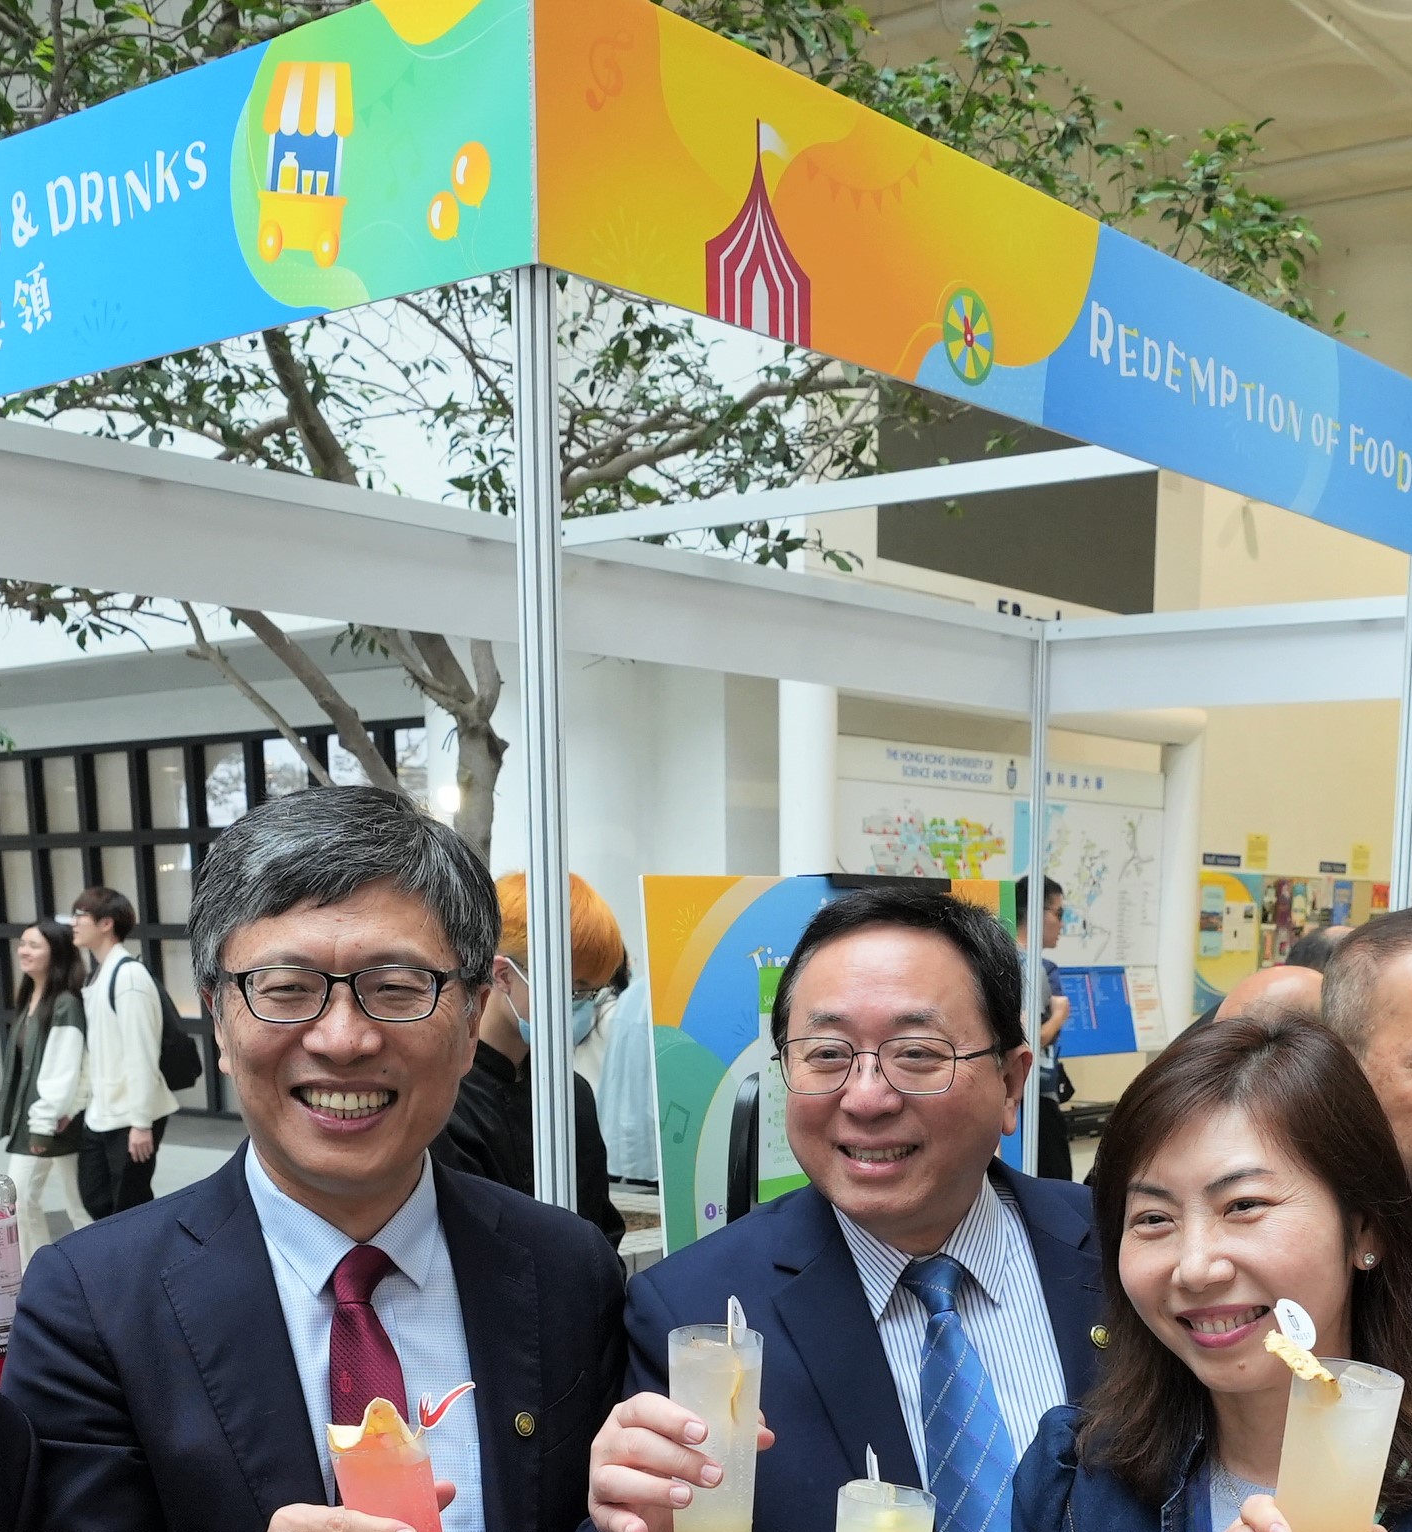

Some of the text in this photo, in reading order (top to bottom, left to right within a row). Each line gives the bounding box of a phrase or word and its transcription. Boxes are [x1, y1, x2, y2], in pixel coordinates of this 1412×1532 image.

[10, 189, 40, 249] &
[45, 140, 208, 236] DRINKS
[1089, 298, 1303, 443] REDEMPTION
[1310, 411, 1339, 456] OF
[1349, 425, 1412, 493] FOOD
